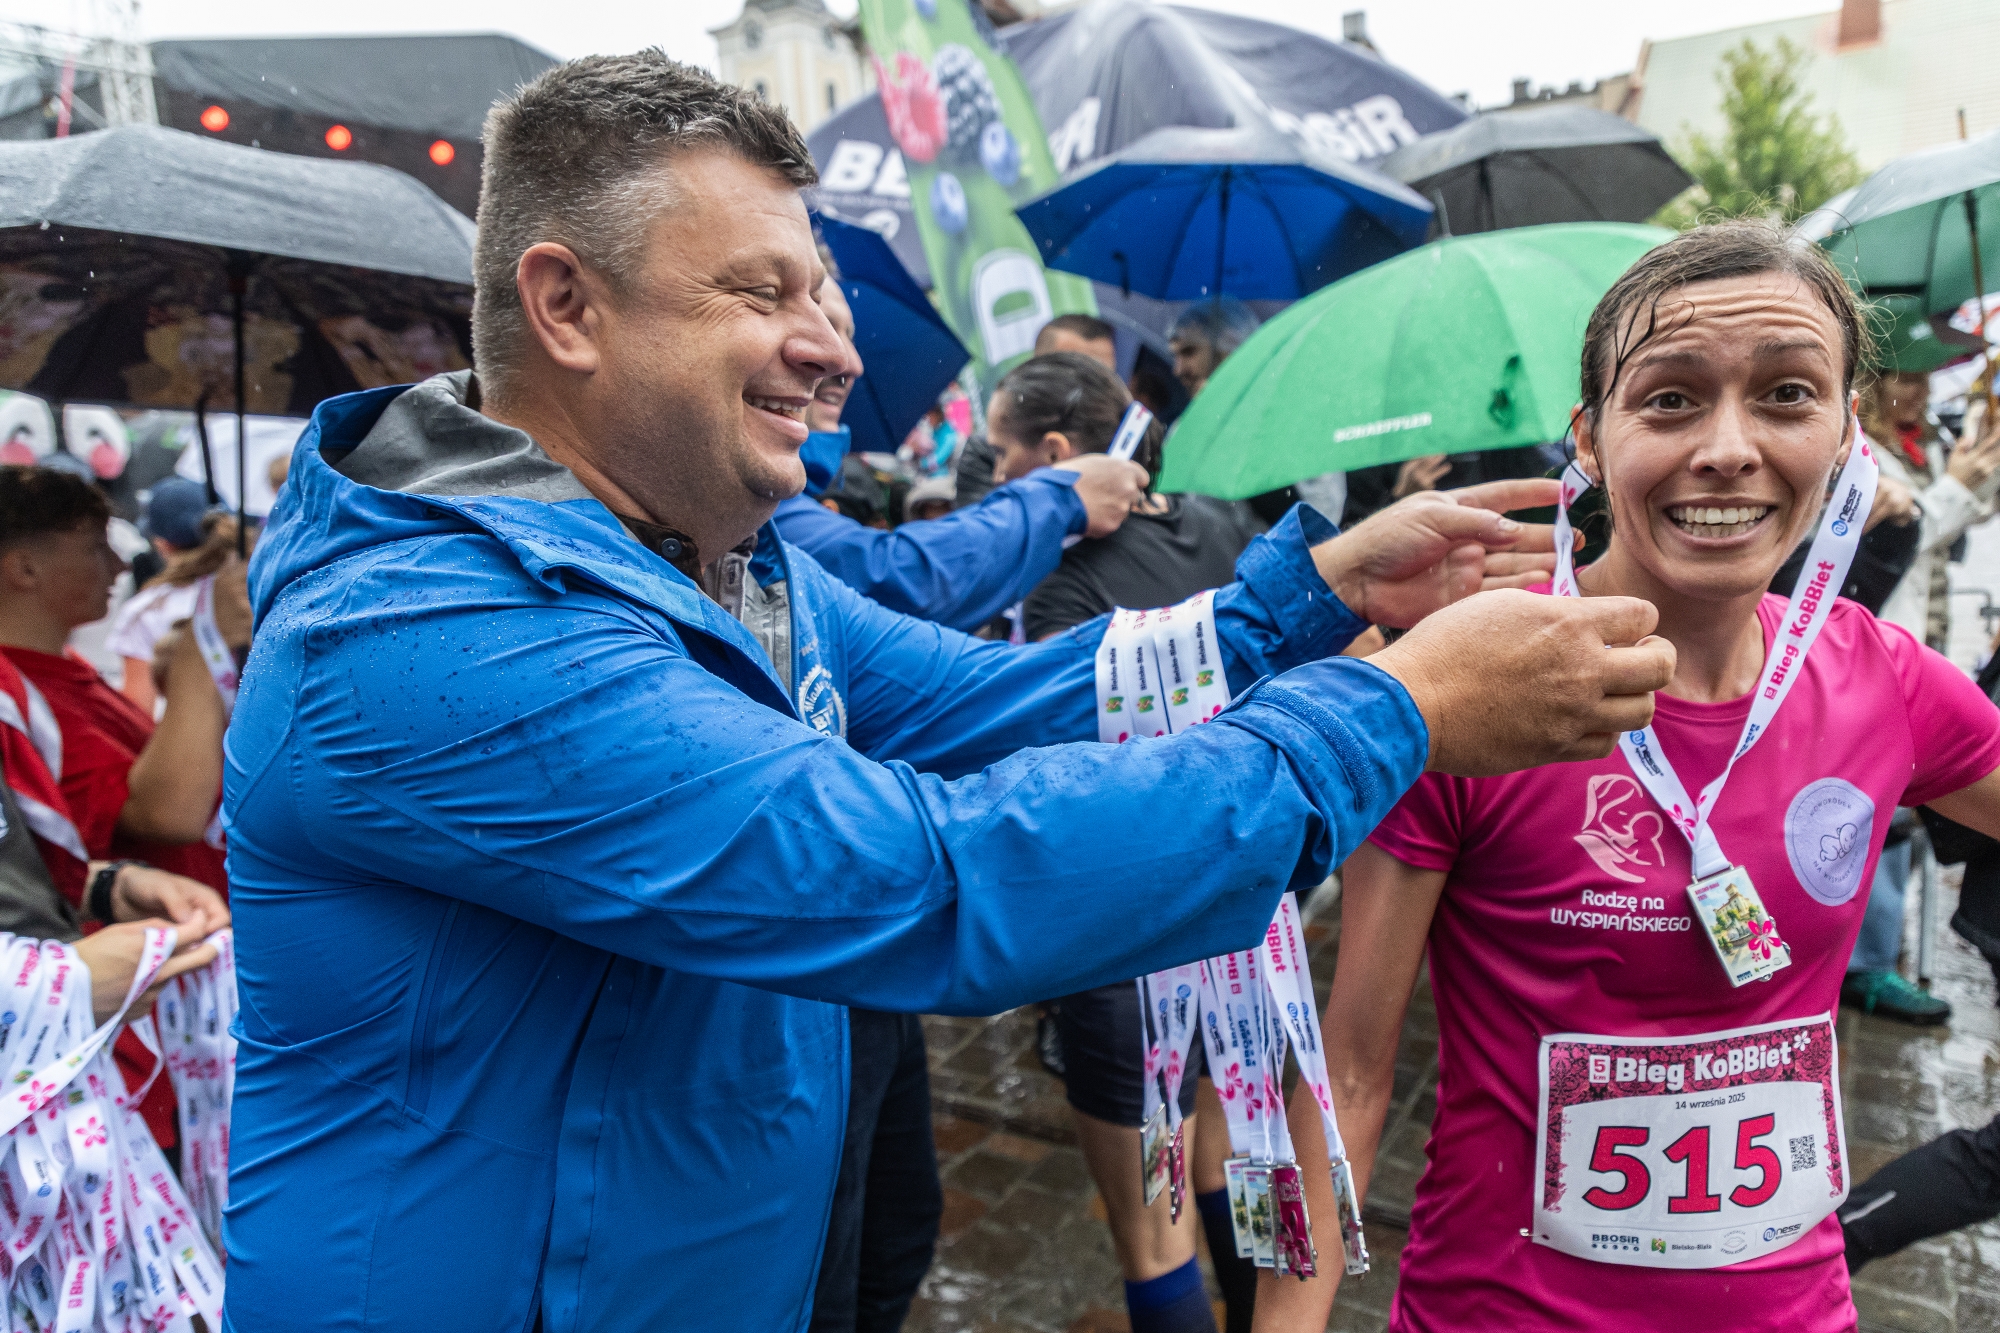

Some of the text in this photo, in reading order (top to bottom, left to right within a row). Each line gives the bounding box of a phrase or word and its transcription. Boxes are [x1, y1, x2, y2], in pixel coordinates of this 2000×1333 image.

[1770, 643, 1800, 686] Bieg
[1789, 561, 1835, 638] KoBBiet
[1582, 889, 1665, 912] Rodzę na
[1551, 908, 1691, 932] WYSPIAŃSKIEGO
[1616, 1041, 1792, 1090] Bieg KoBBiet
[1675, 1093, 1746, 1110] 14 września 2025
[1582, 1112, 1782, 1214] 515
[1592, 1233, 1640, 1244] BBOSiR
